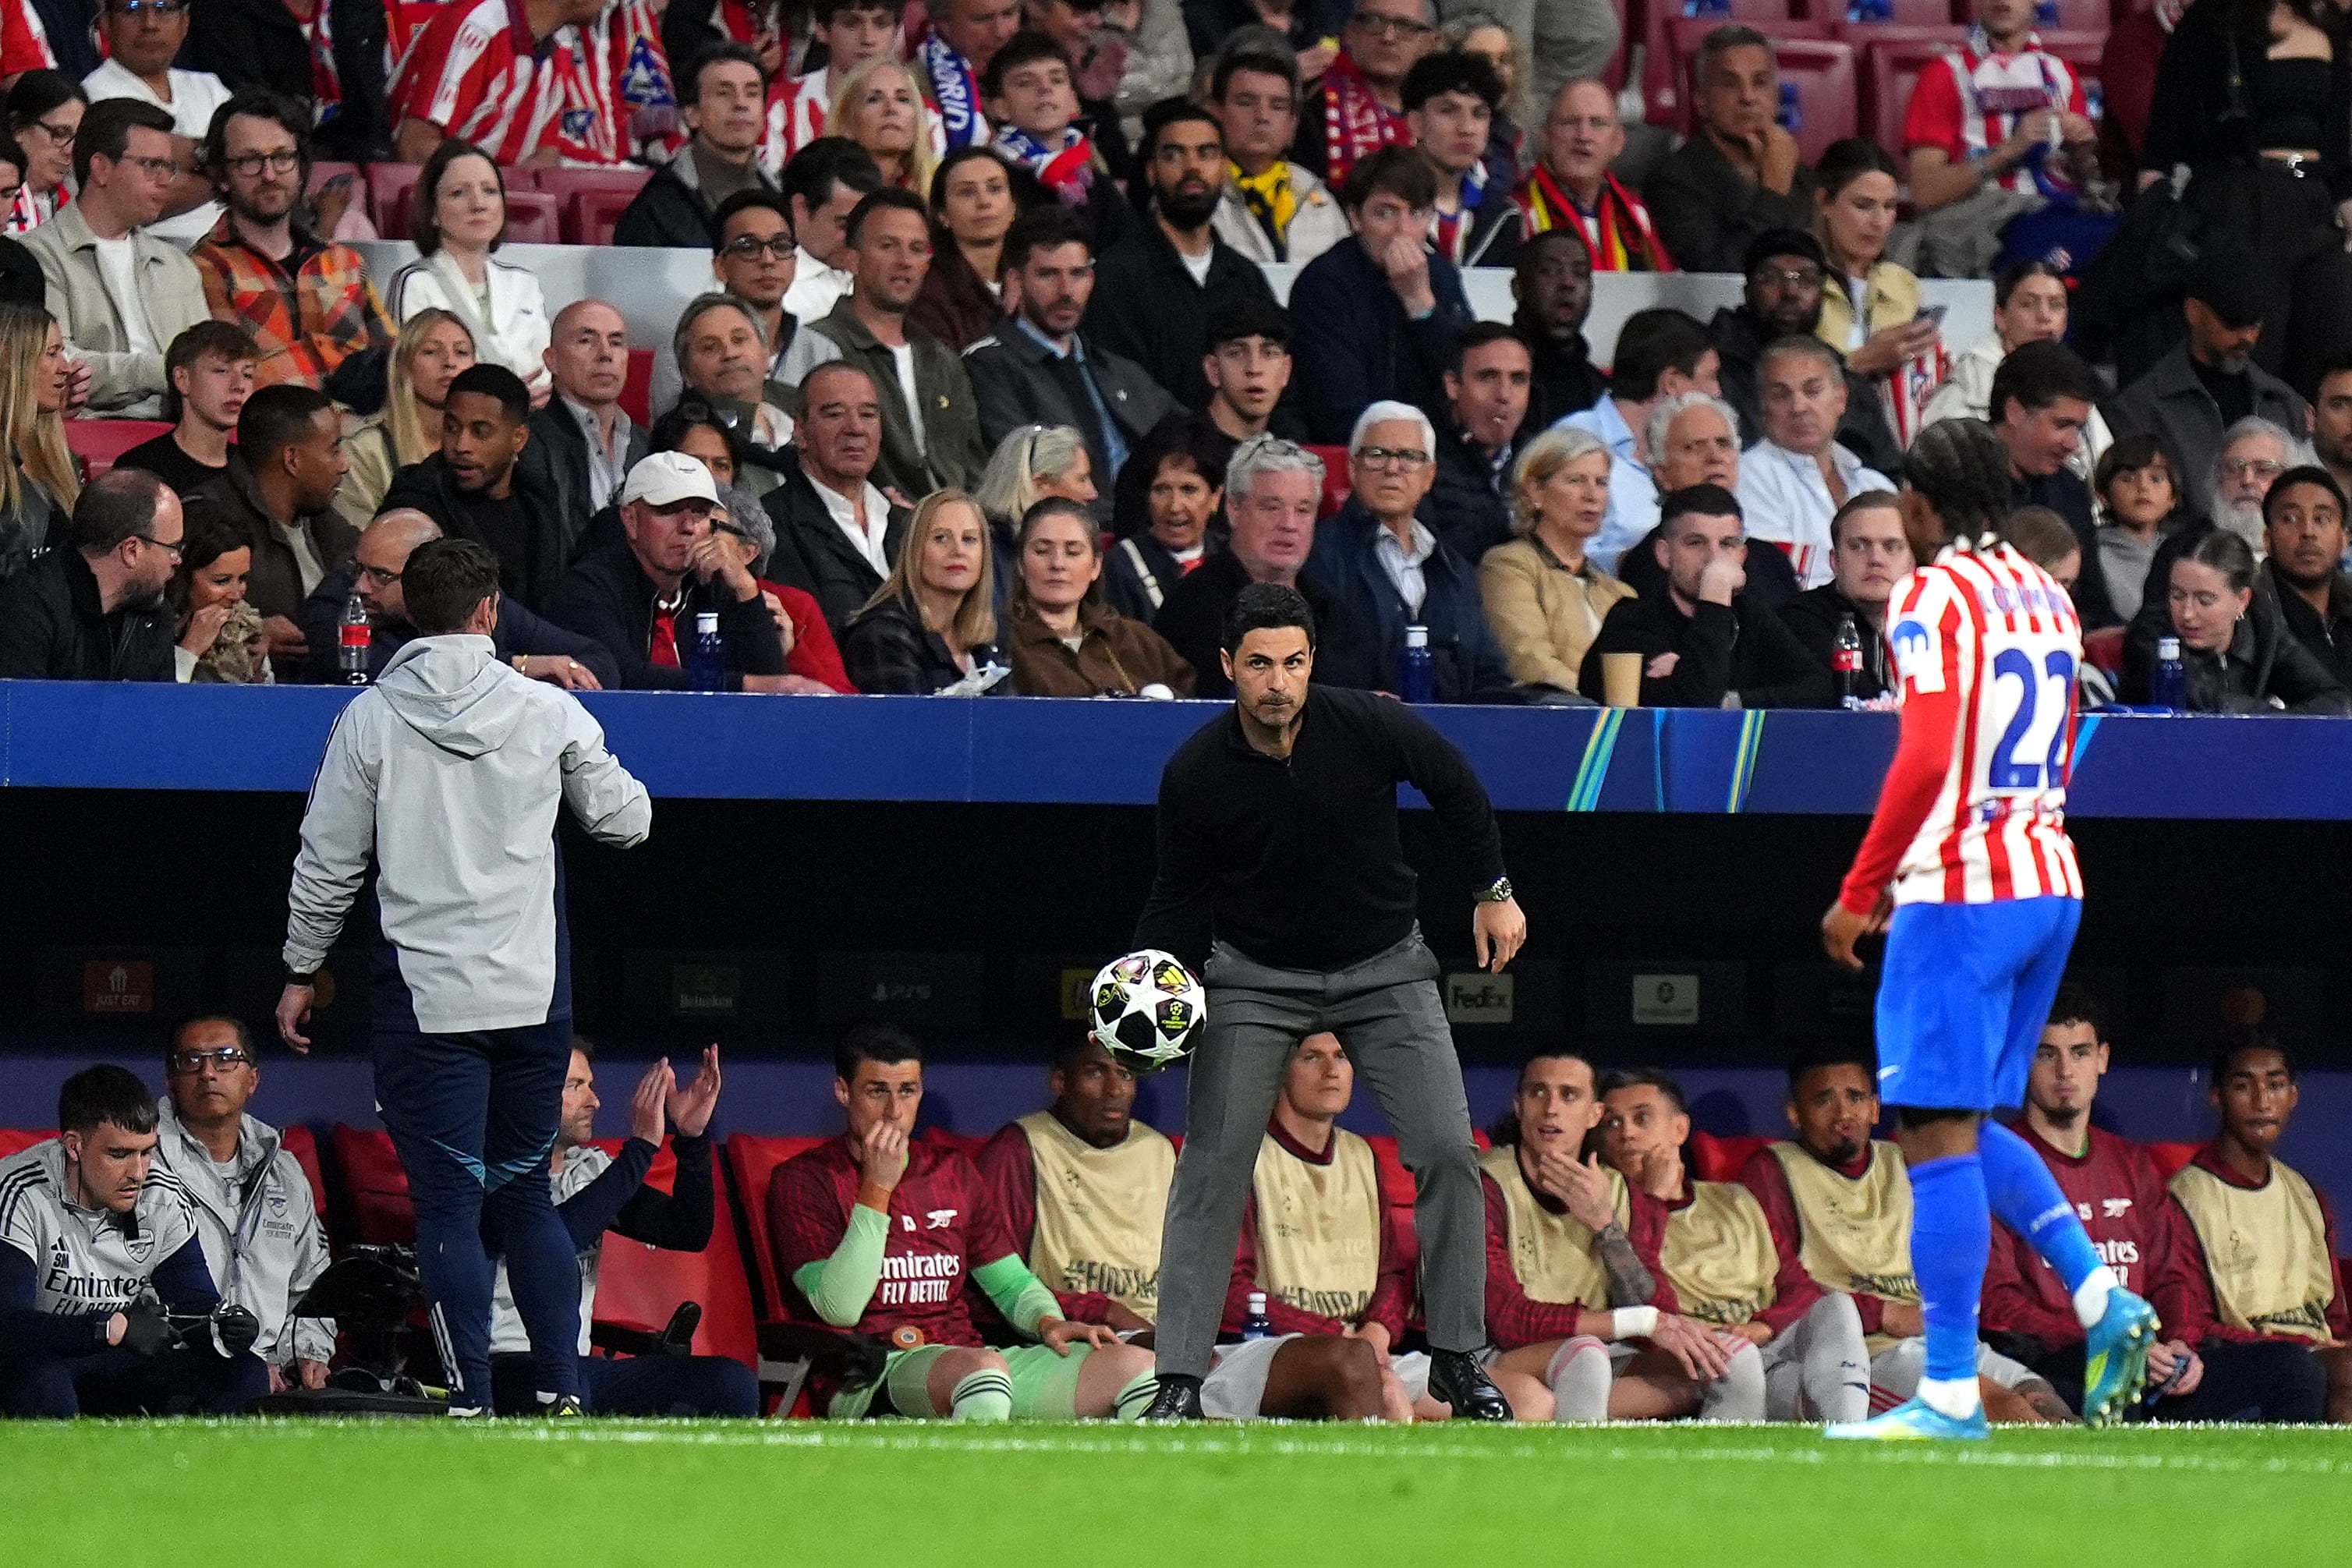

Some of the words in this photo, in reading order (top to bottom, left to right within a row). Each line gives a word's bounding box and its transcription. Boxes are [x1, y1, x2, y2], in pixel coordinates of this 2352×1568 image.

[1989, 648, 2074, 790] 22
[95, 994, 120, 1007] JUST
[122, 994, 141, 1006] EAT
[1451, 985, 1507, 1009] FedEx
[880, 1250, 960, 1280] mirates
[882, 1281, 907, 1304] FLY
